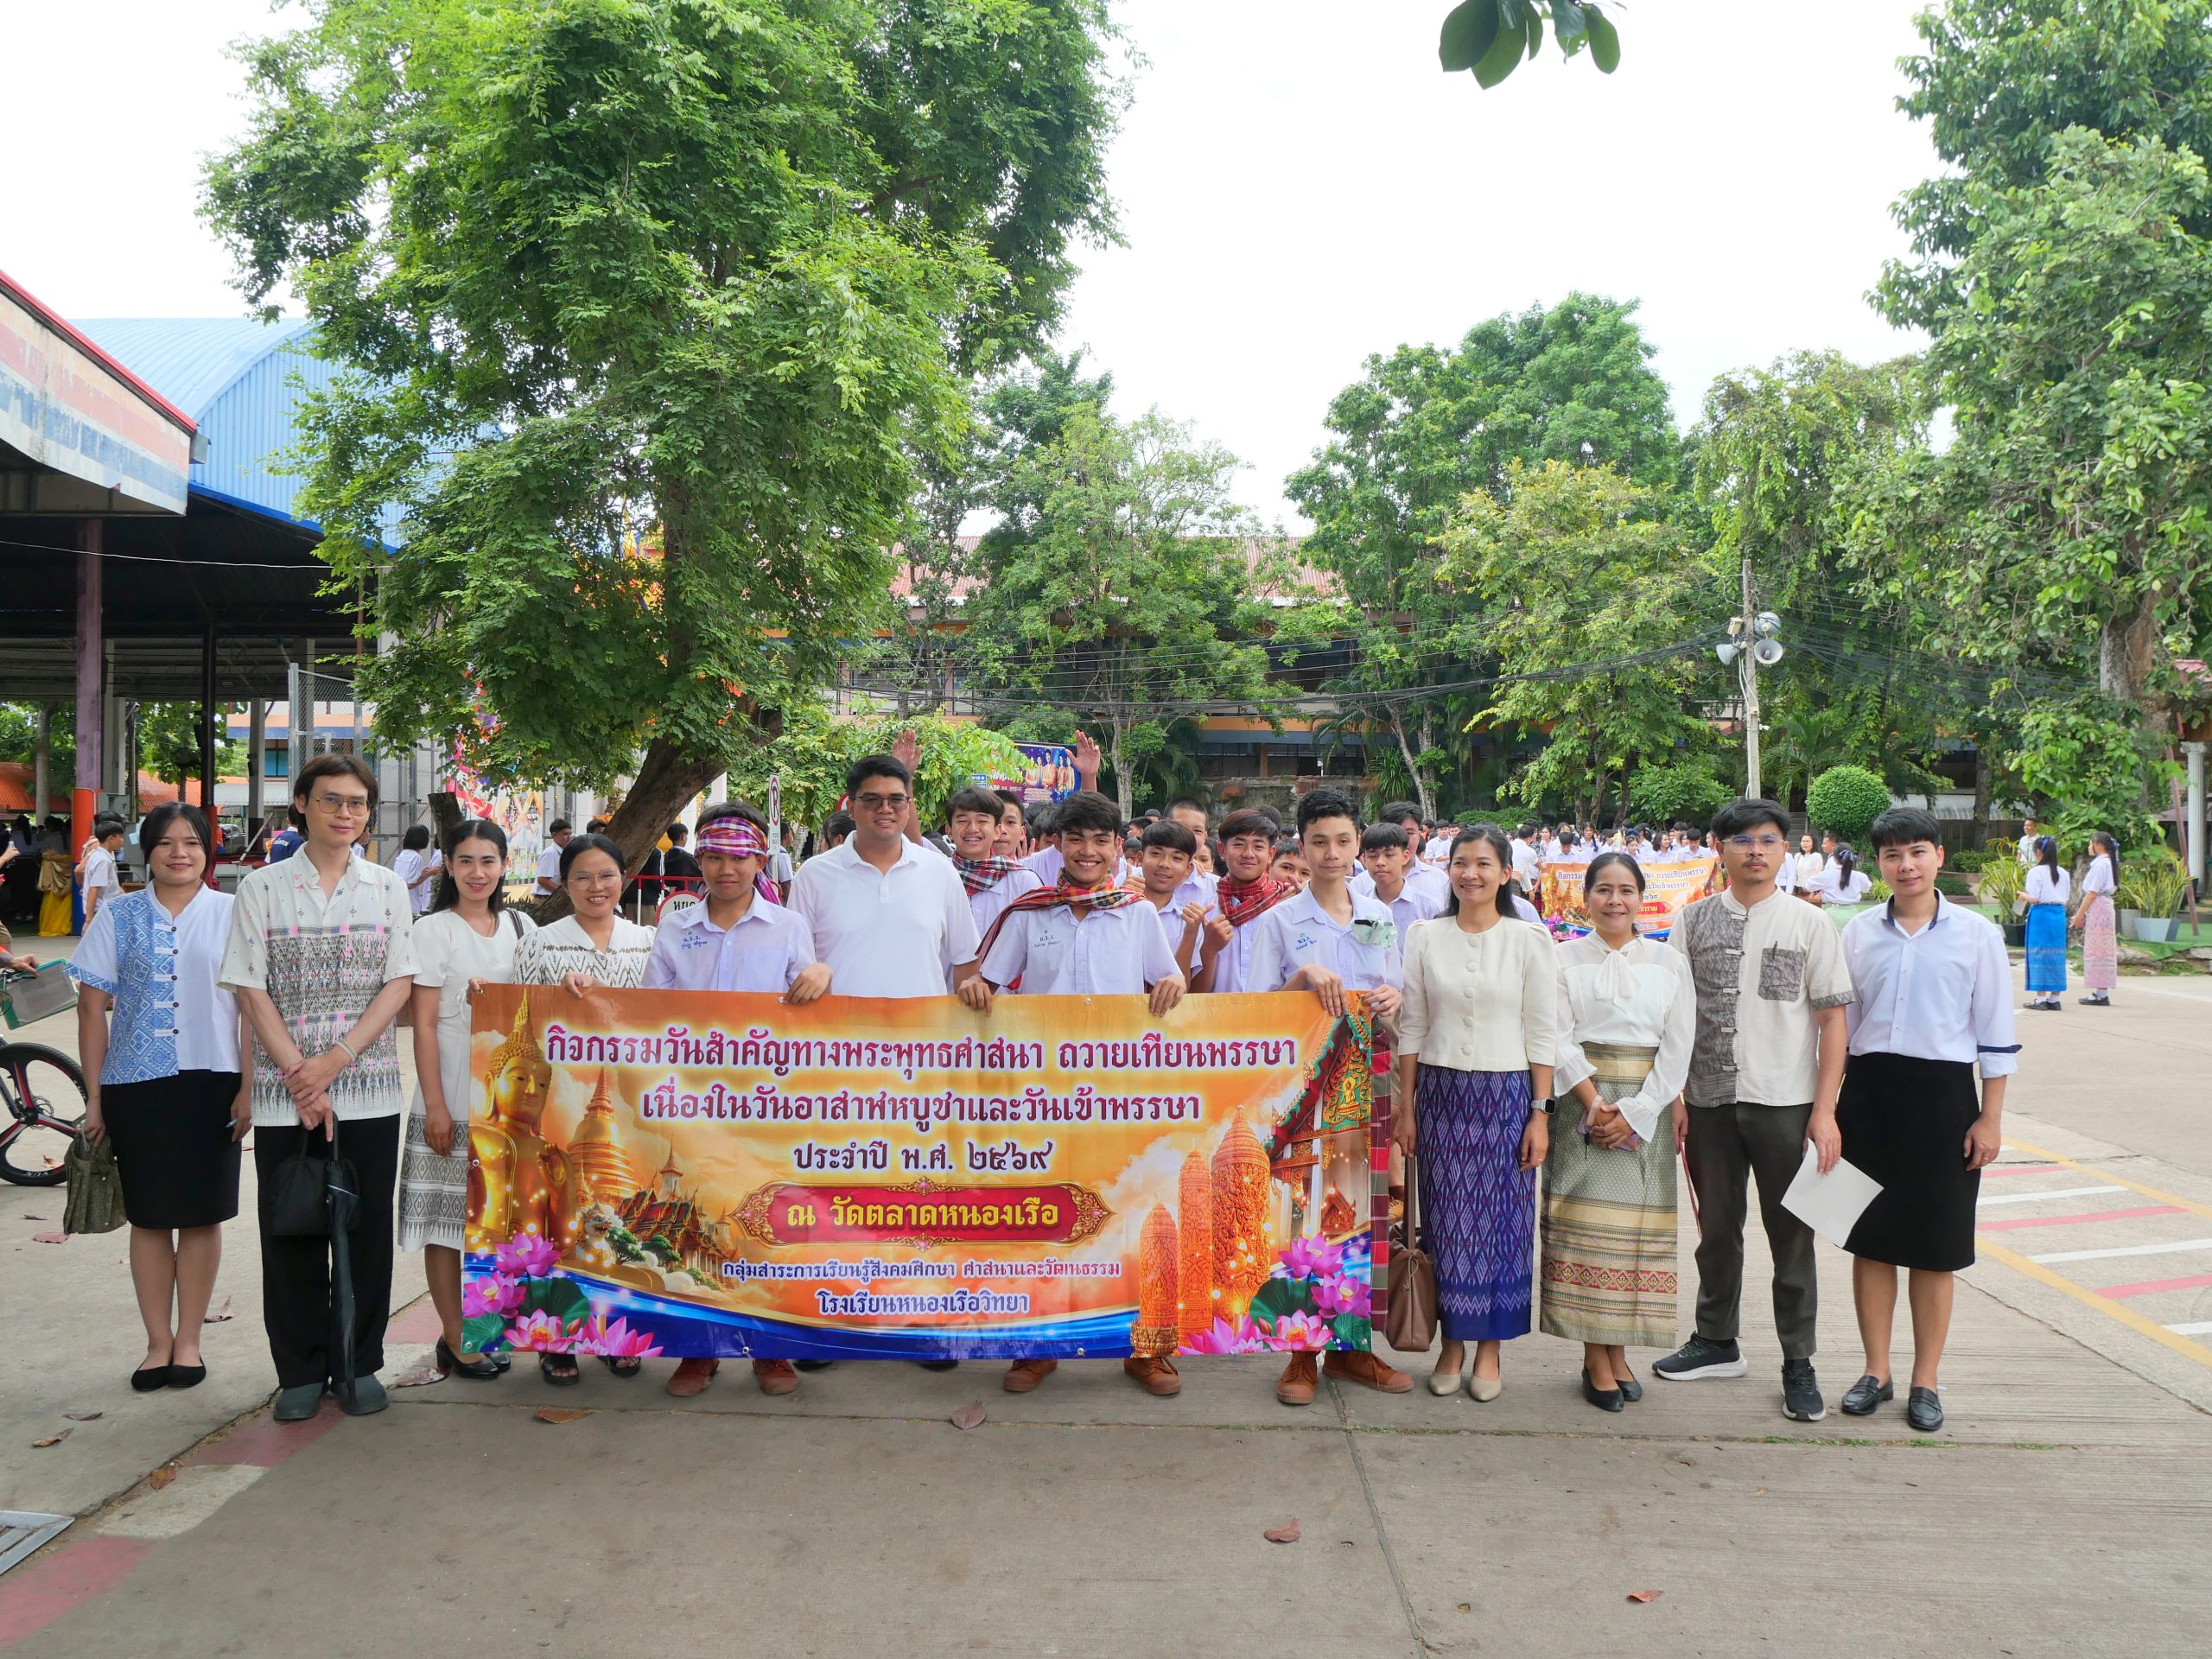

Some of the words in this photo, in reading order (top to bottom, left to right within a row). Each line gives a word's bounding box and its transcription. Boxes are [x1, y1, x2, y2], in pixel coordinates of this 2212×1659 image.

[547, 1024, 1042, 1080] กิจกรรมวันสำคัญทางพระพุทธศาสนา
[1058, 1033, 1296, 1069] ถวายเทียนพรรษา
[643, 1076, 1199, 1133] เนื่องในวันอาสาฬหบูชาและวันเข้าพรรษา
[794, 1141, 888, 1170] ประจำปี
[901, 1144, 954, 1170] พ.ศ.
[968, 1141, 1053, 1171] ๒๕๖๙
[787, 1204, 816, 1226] ณ
[830, 1196, 1059, 1226] วัดตลาดหนองเรือ
[723, 1259, 955, 1283] กลุ่มสาระการเรียนรู้สังคมศึกษา
[963, 1259, 1121, 1276] ศาสนาและวัฒนธรรม
[817, 1290, 1028, 1313] โรงเรียนหนองเรือวิทยา
